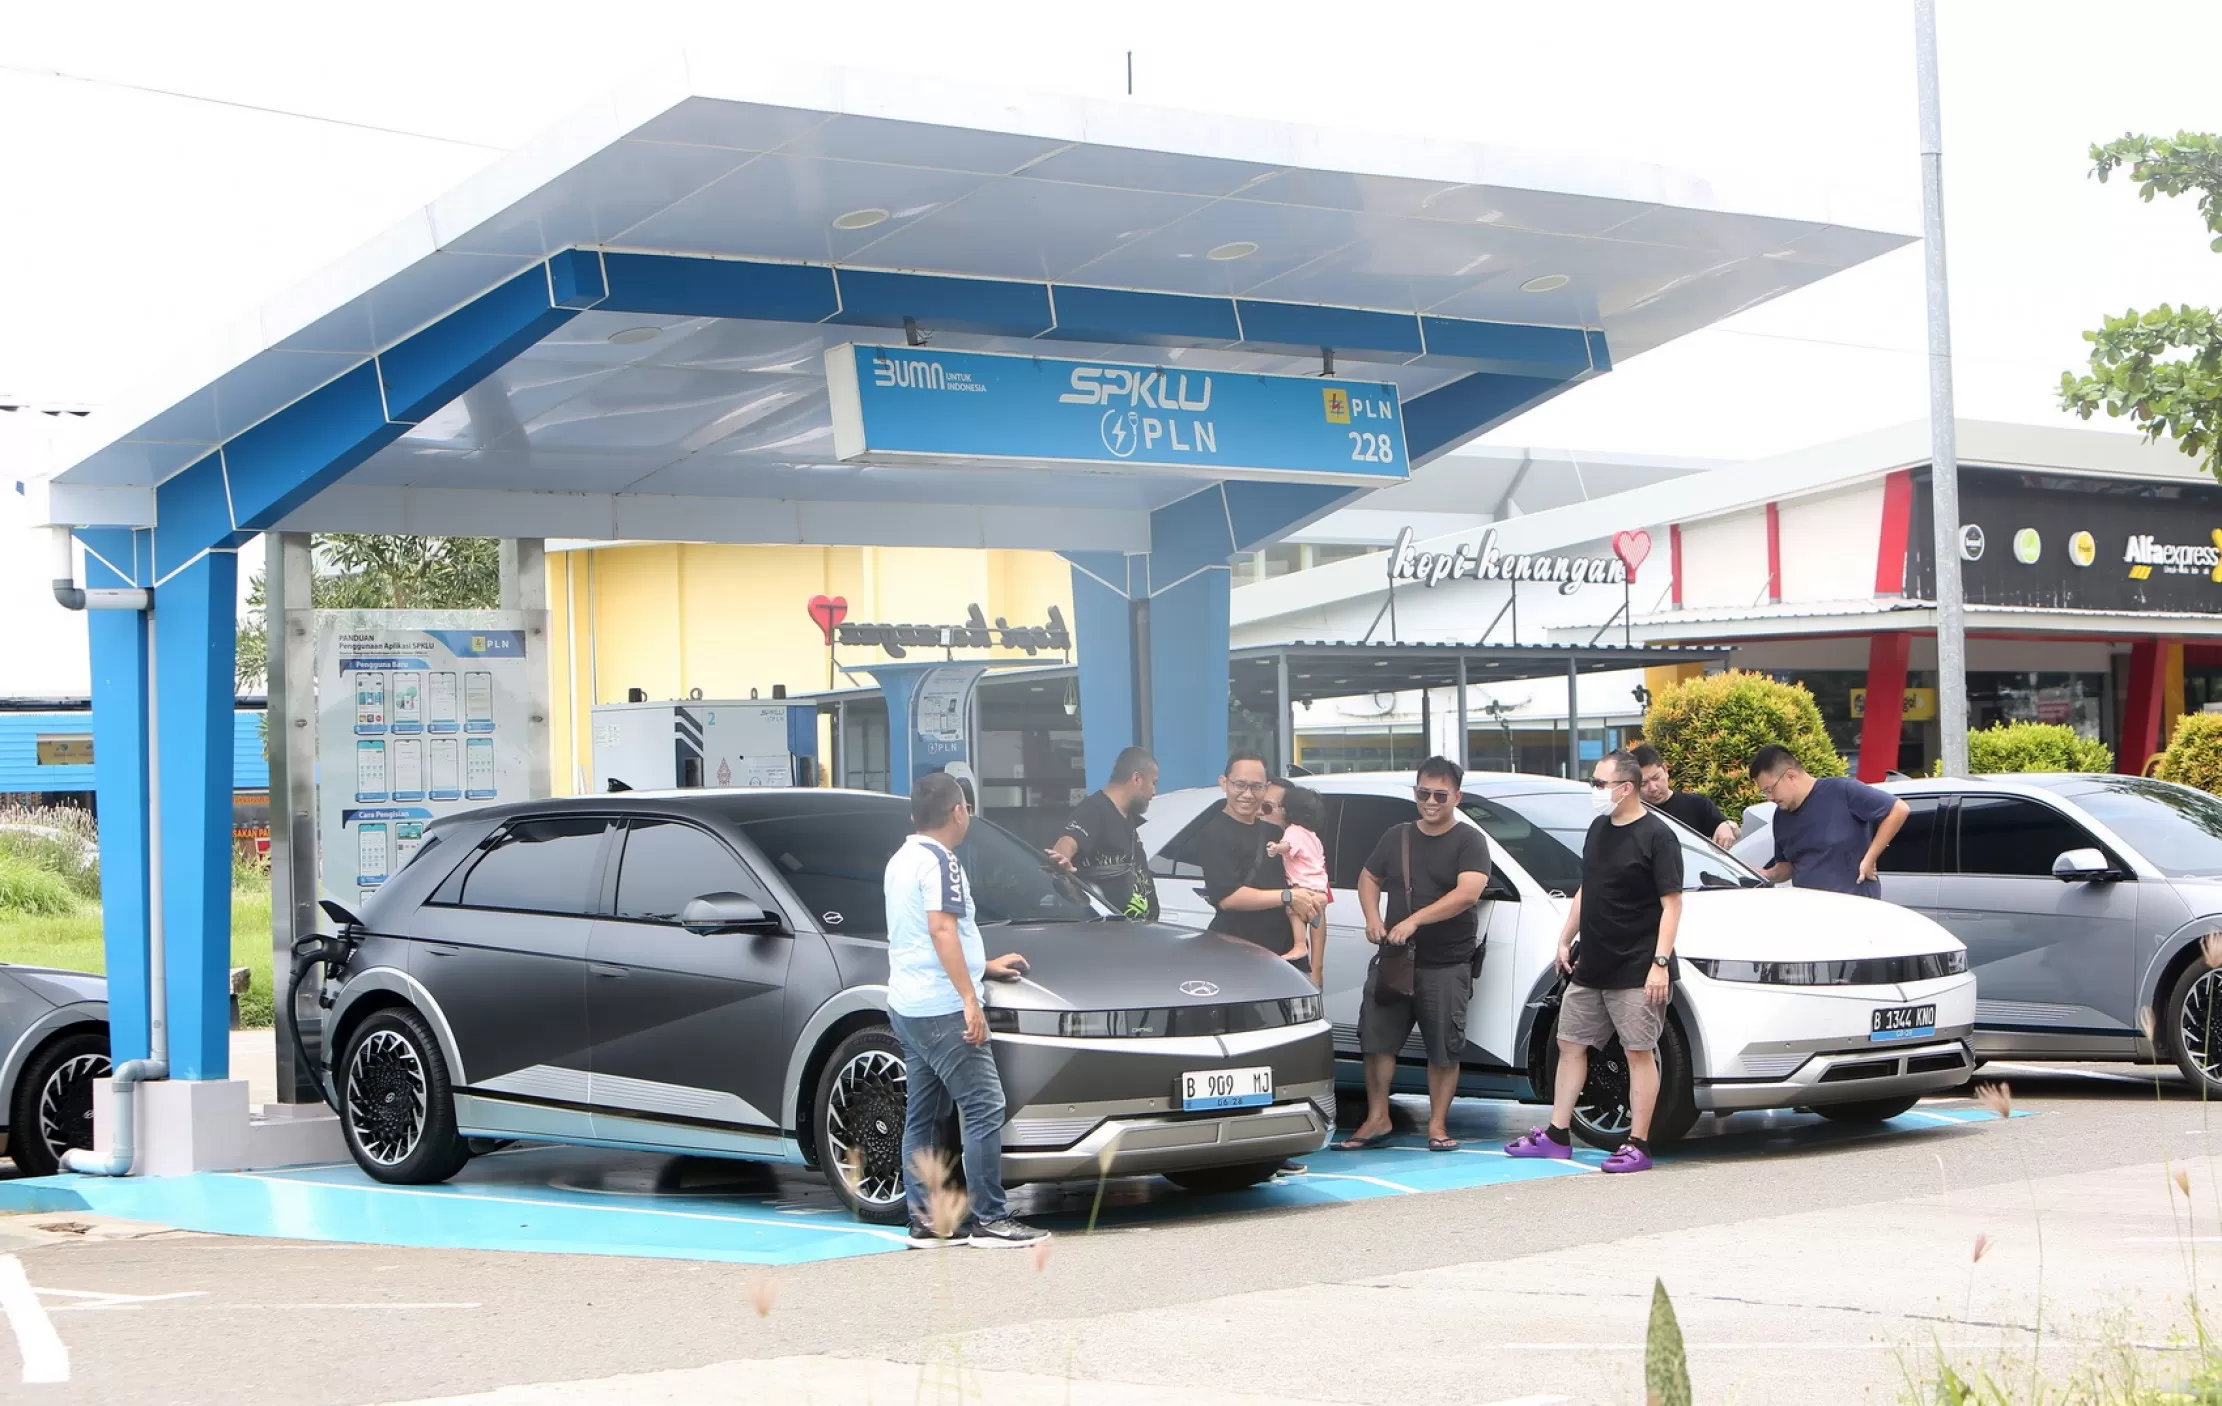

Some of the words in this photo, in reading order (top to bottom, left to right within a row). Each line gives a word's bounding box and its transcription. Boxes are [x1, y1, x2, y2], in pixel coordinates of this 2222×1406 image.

[945, 372, 972, 382] UNTUK
[947, 382, 987, 393] INDONESIA
[1058, 367, 1212, 412] SPKLU
[1352, 398, 1392, 420] PLN
[1142, 417, 1217, 453] PLN
[1348, 431, 1393, 464] 228
[487, 640, 510, 648] PLN
[707, 712, 716, 726] 2
[1873, 1012, 1882, 1030] B
[1885, 1009, 1912, 1029] 1344
[1186, 1077, 1196, 1098] B
[1208, 1074, 1234, 1097] 909
[1253, 1073, 1270, 1093] MJ
